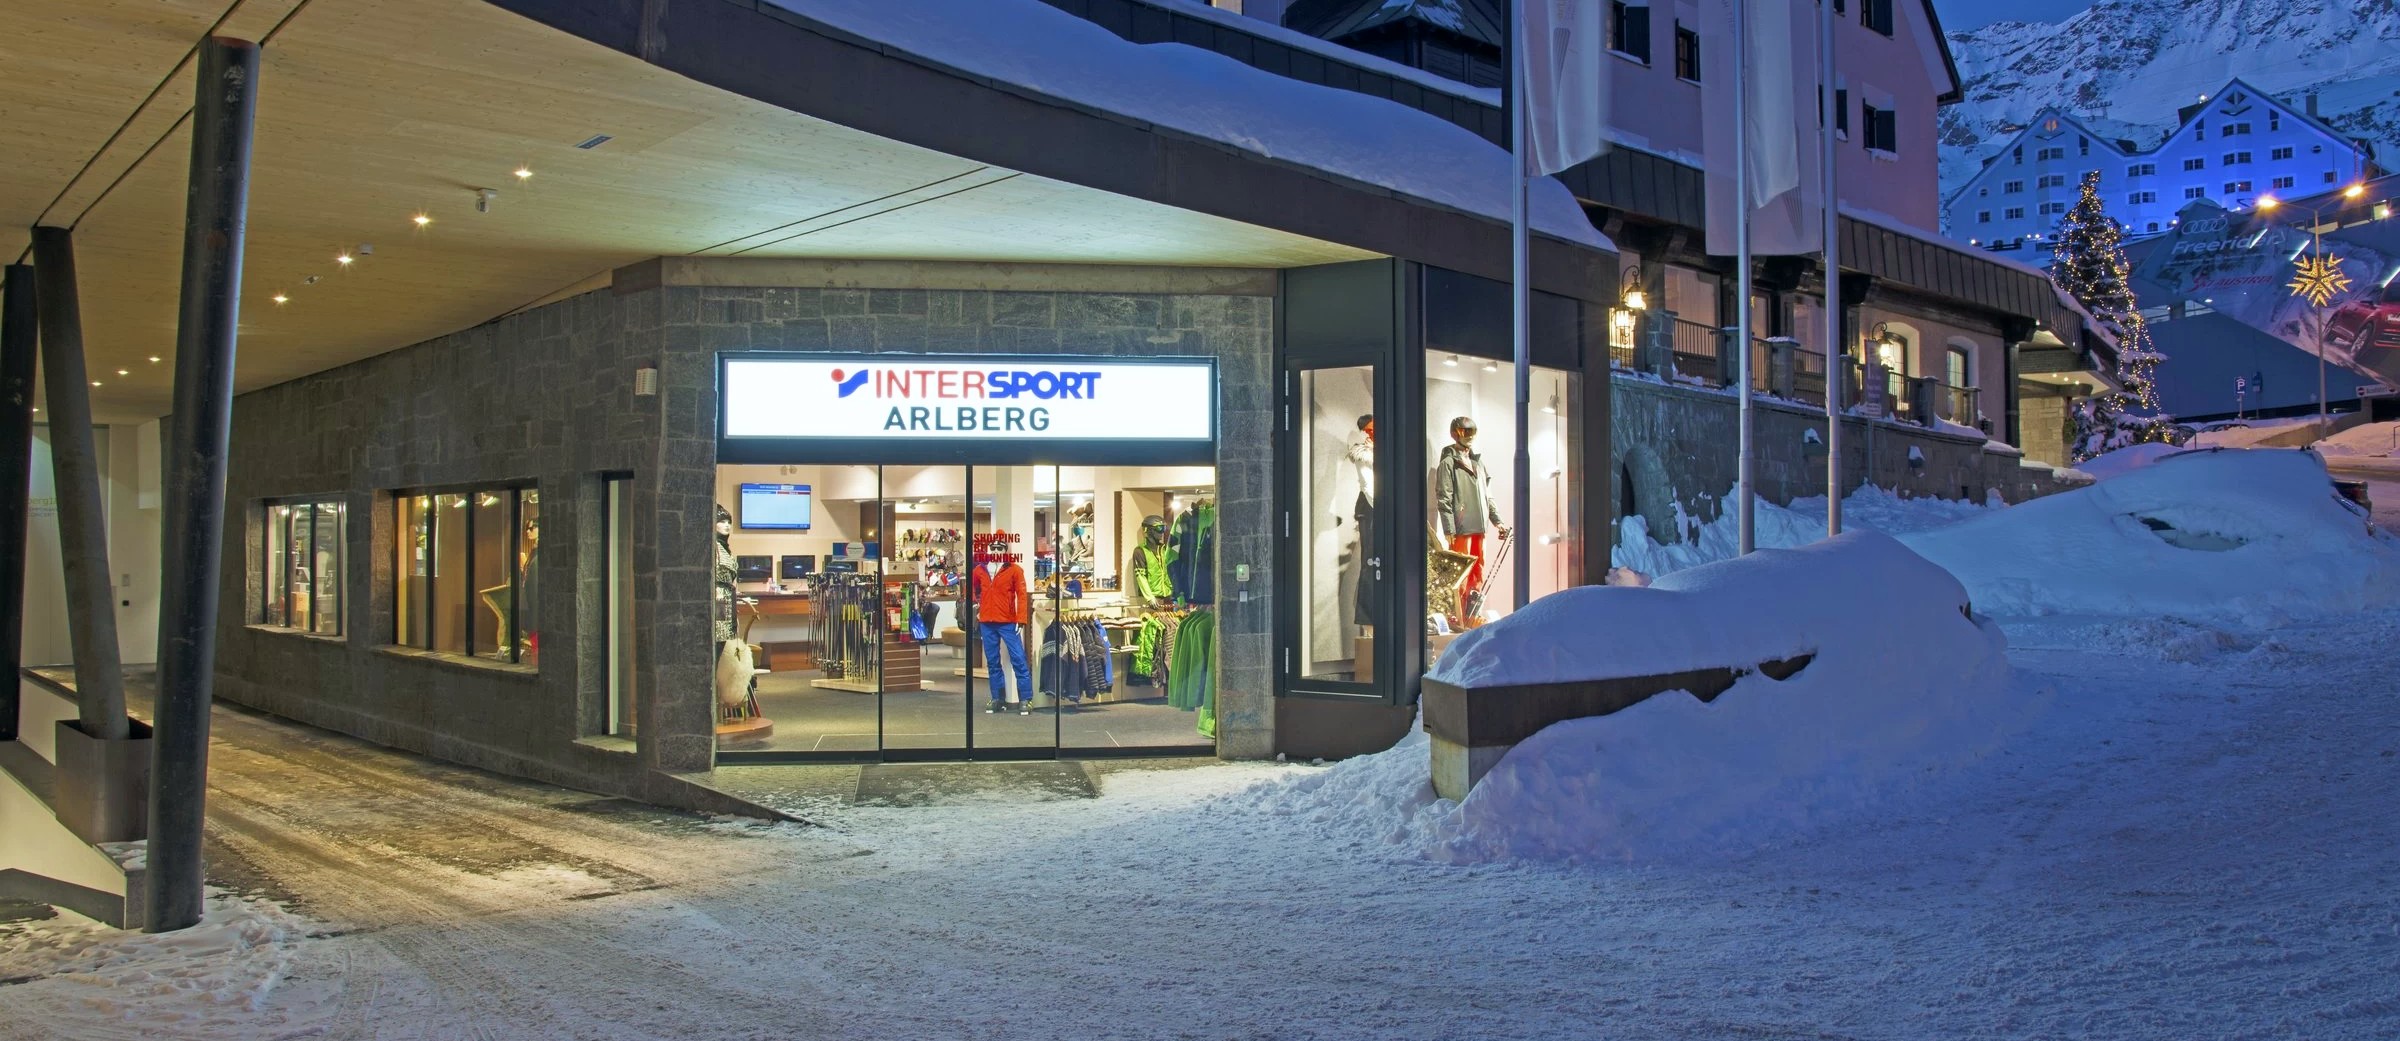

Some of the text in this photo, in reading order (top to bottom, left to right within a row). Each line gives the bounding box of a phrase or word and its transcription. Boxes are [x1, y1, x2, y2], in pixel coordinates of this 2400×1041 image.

[876, 370, 1101, 399] INTERSPORT
[2237, 381, 2246, 391] P
[883, 406, 1050, 431] ARLBERG
[974, 533, 1021, 543] SHOPPING
